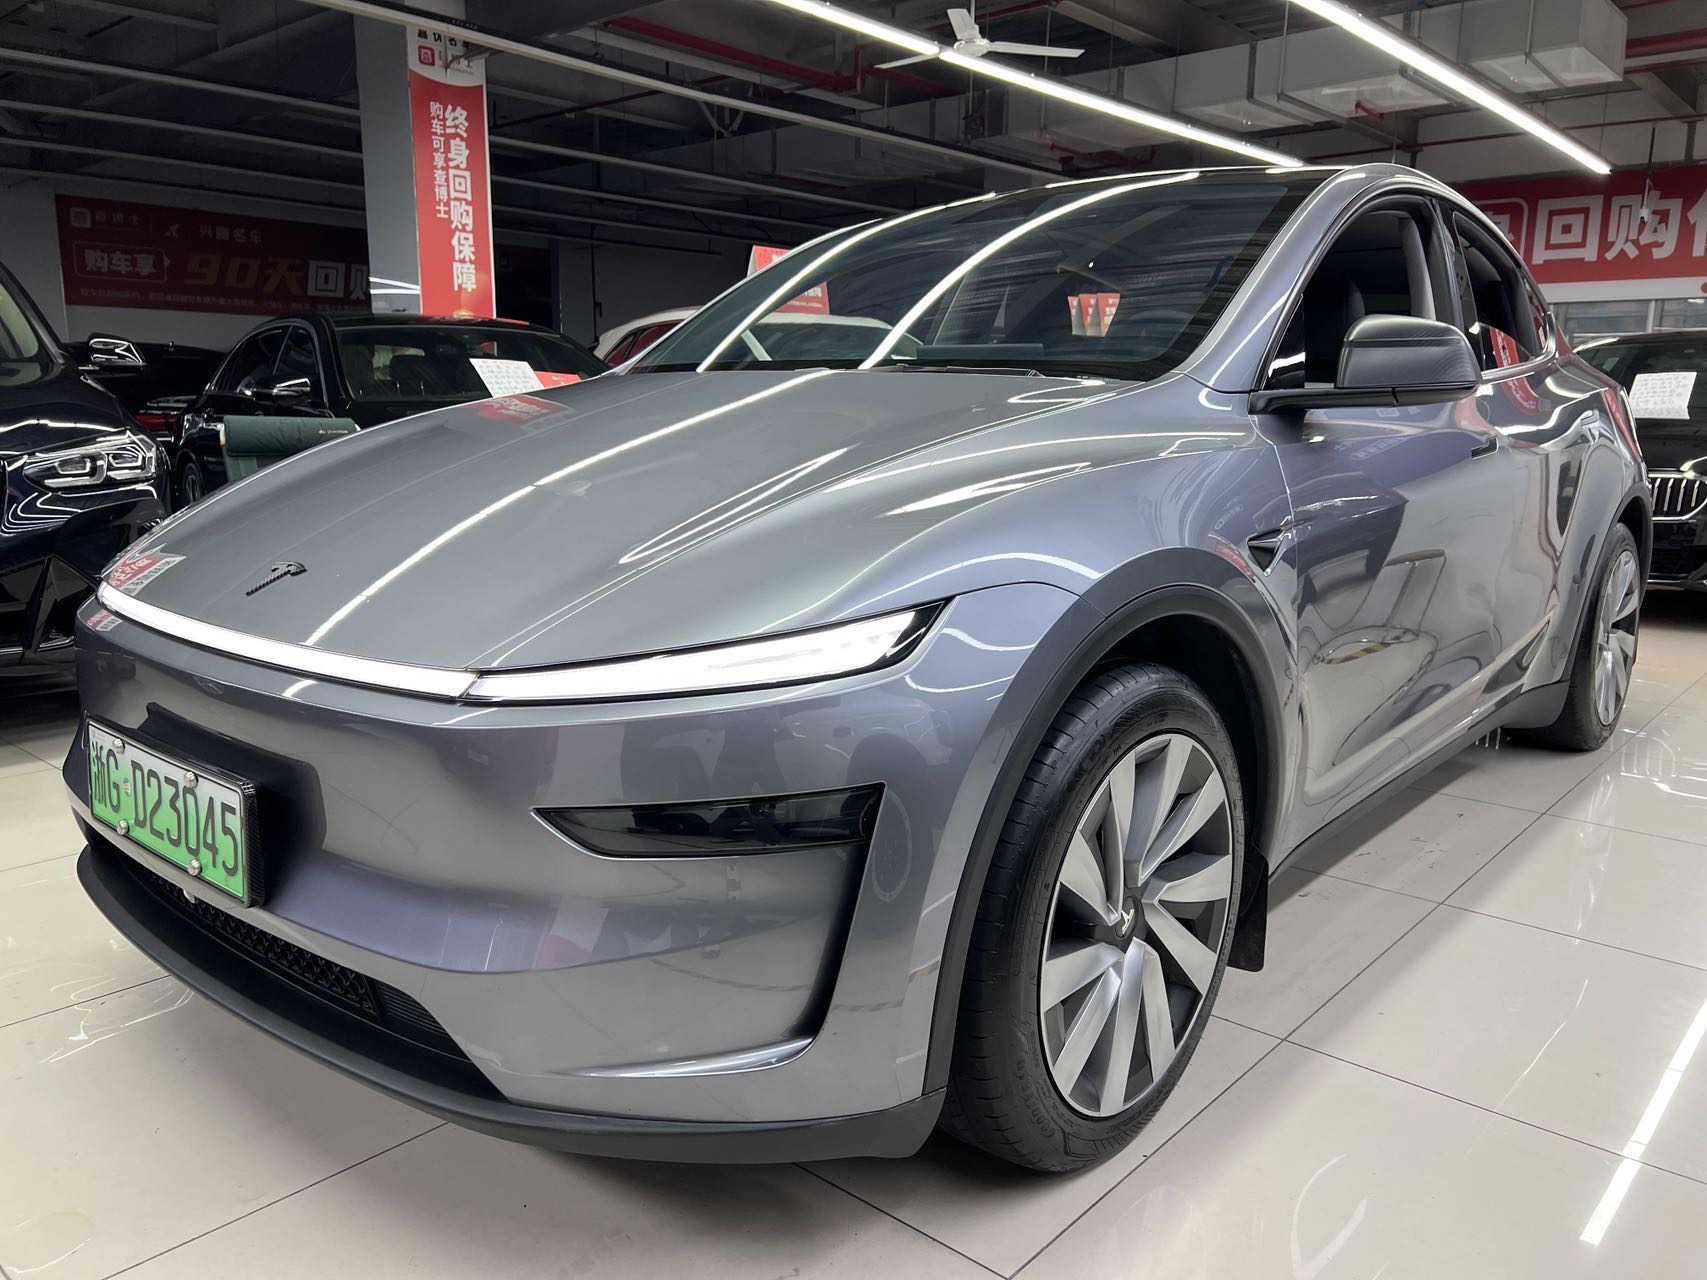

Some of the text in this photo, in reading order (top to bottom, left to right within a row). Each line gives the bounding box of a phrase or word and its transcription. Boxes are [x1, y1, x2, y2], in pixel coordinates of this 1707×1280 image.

[430, 101, 449, 220] 购车可享查博士
[444, 103, 477, 292] 终身回购保障
[91, 740, 239, 877] 浙G D23045
